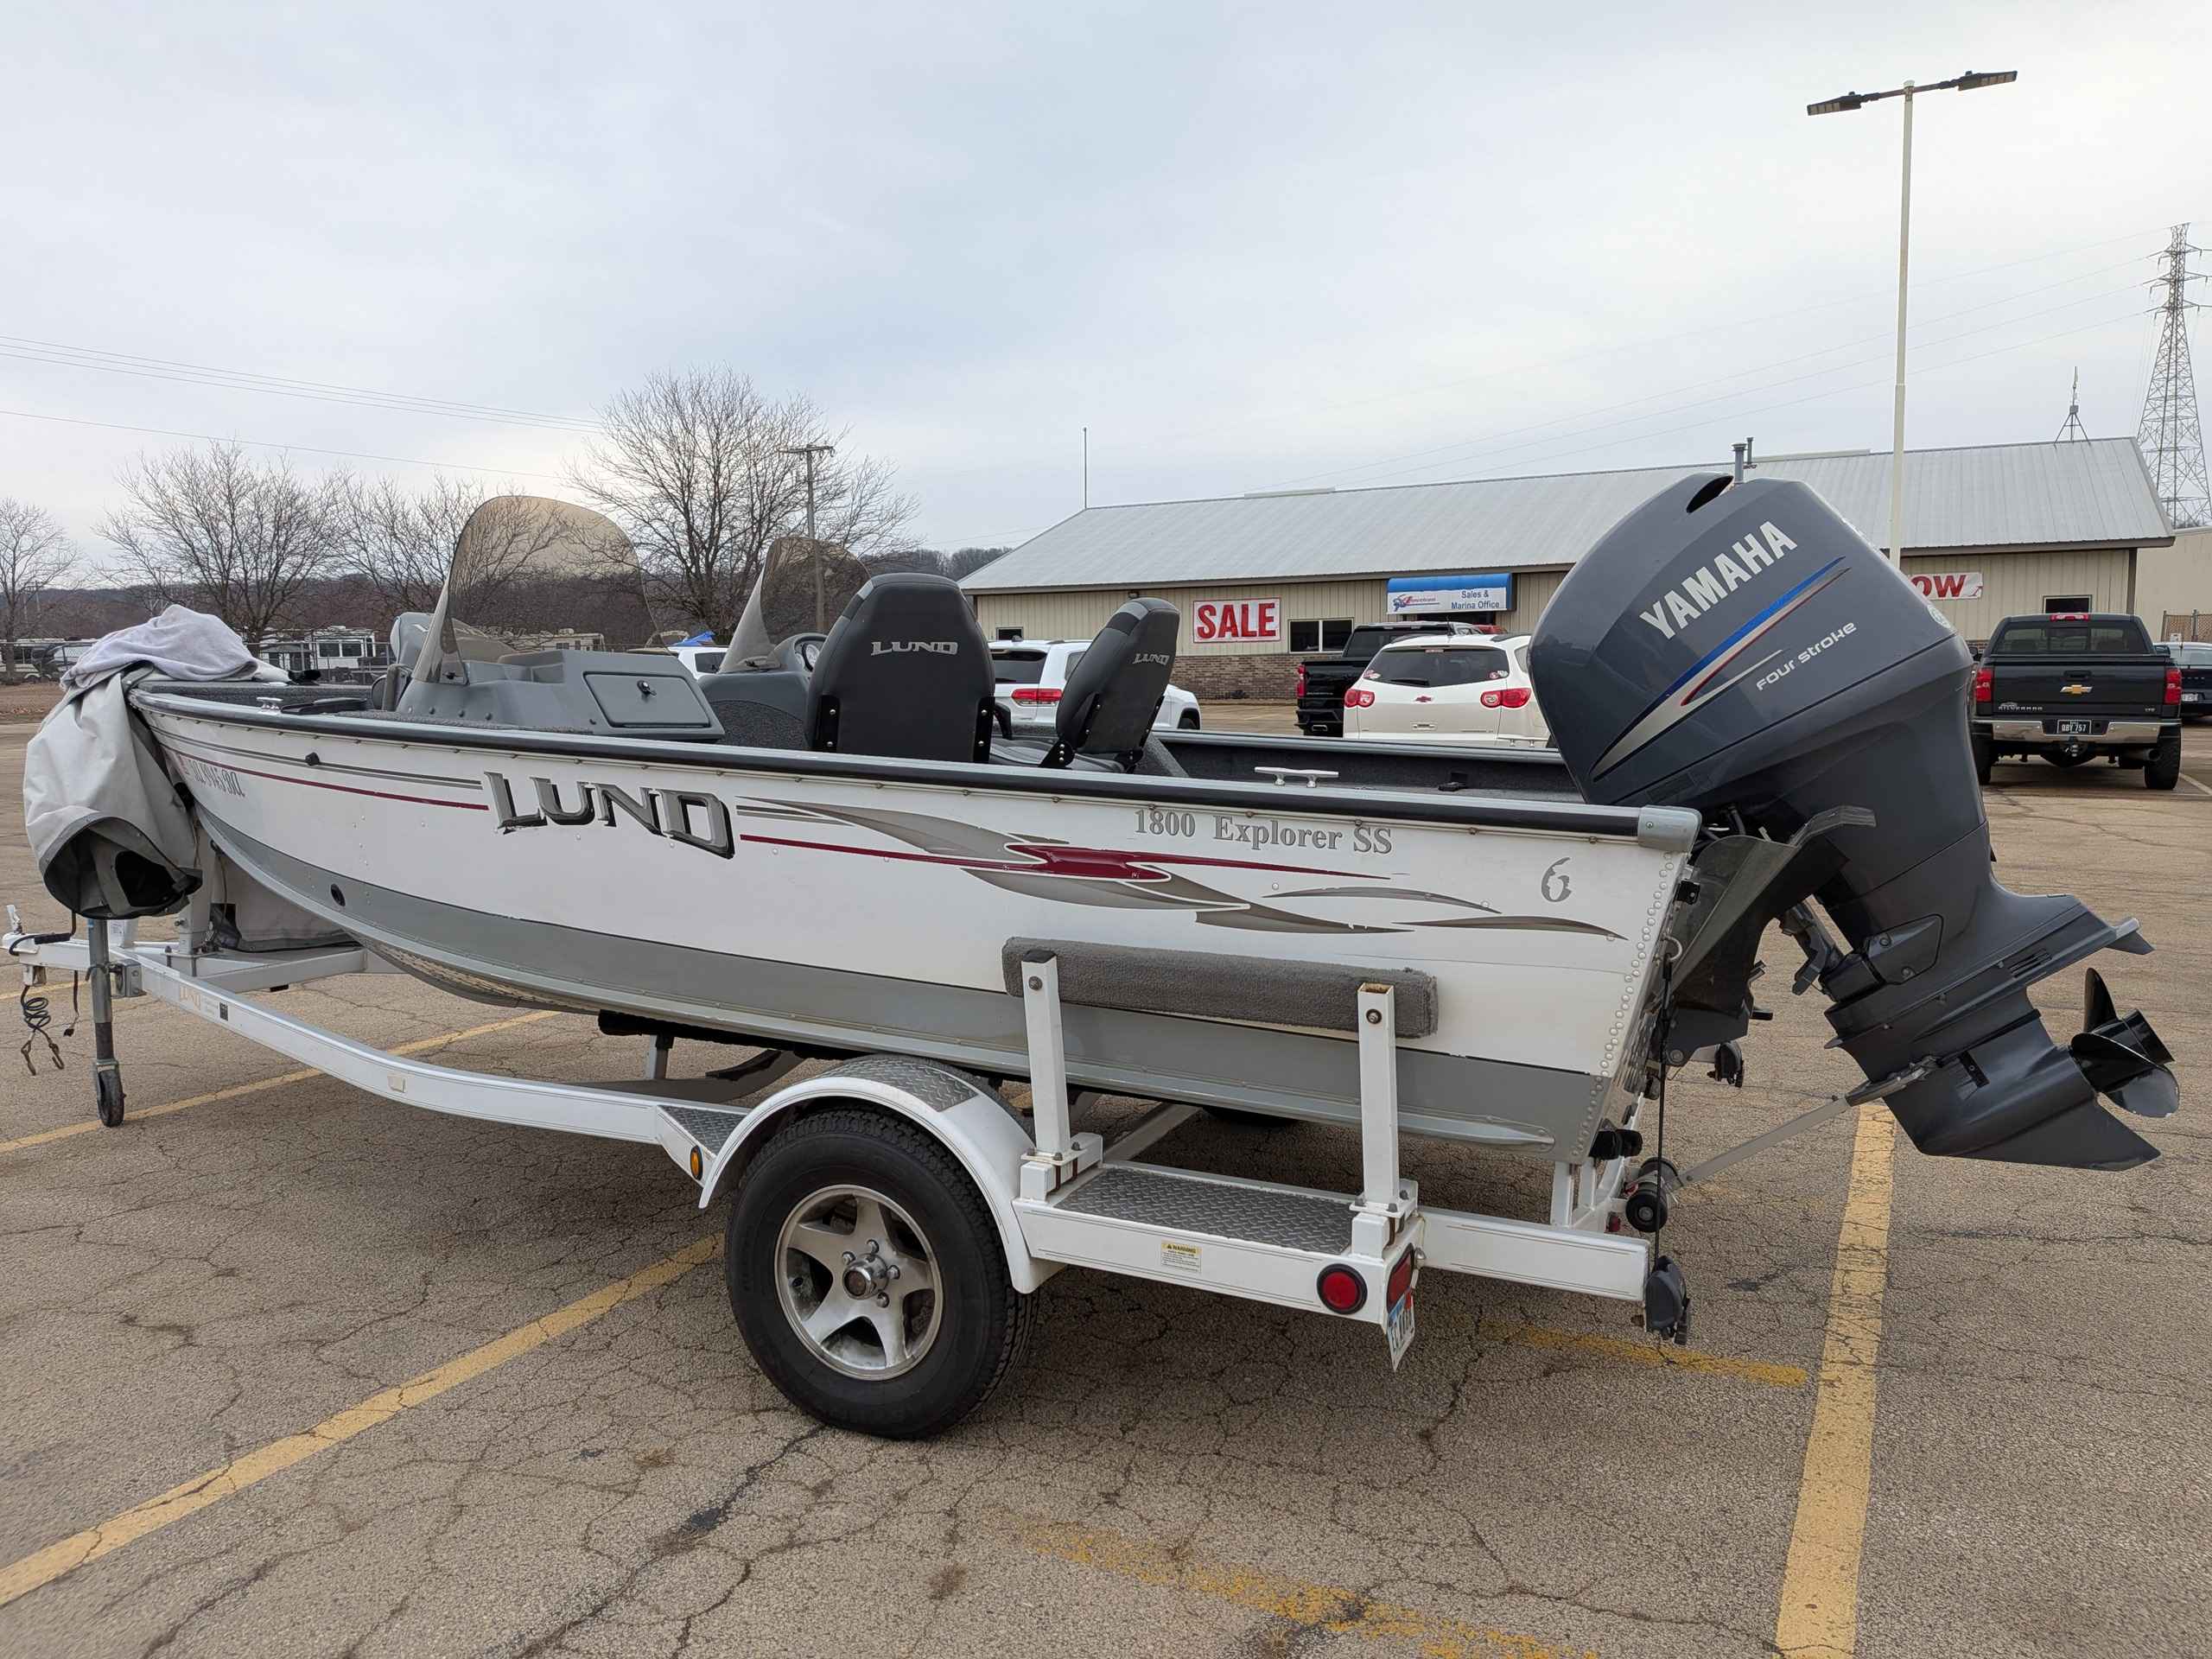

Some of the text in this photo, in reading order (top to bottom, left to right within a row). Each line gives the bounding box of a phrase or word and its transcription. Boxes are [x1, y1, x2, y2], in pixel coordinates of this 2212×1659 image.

[1640, 521, 1798, 639] YAMAHA
[1461, 589, 1490, 599] Sales &
[1478, 600, 1500, 608] Office
[1198, 602, 1276, 639] SALE
[870, 641, 958, 657] LUND
[1132, 652, 1170, 666] LUND
[484, 771, 734, 860] LUND
[1134, 808, 1394, 855] 1800 Explorer SS
